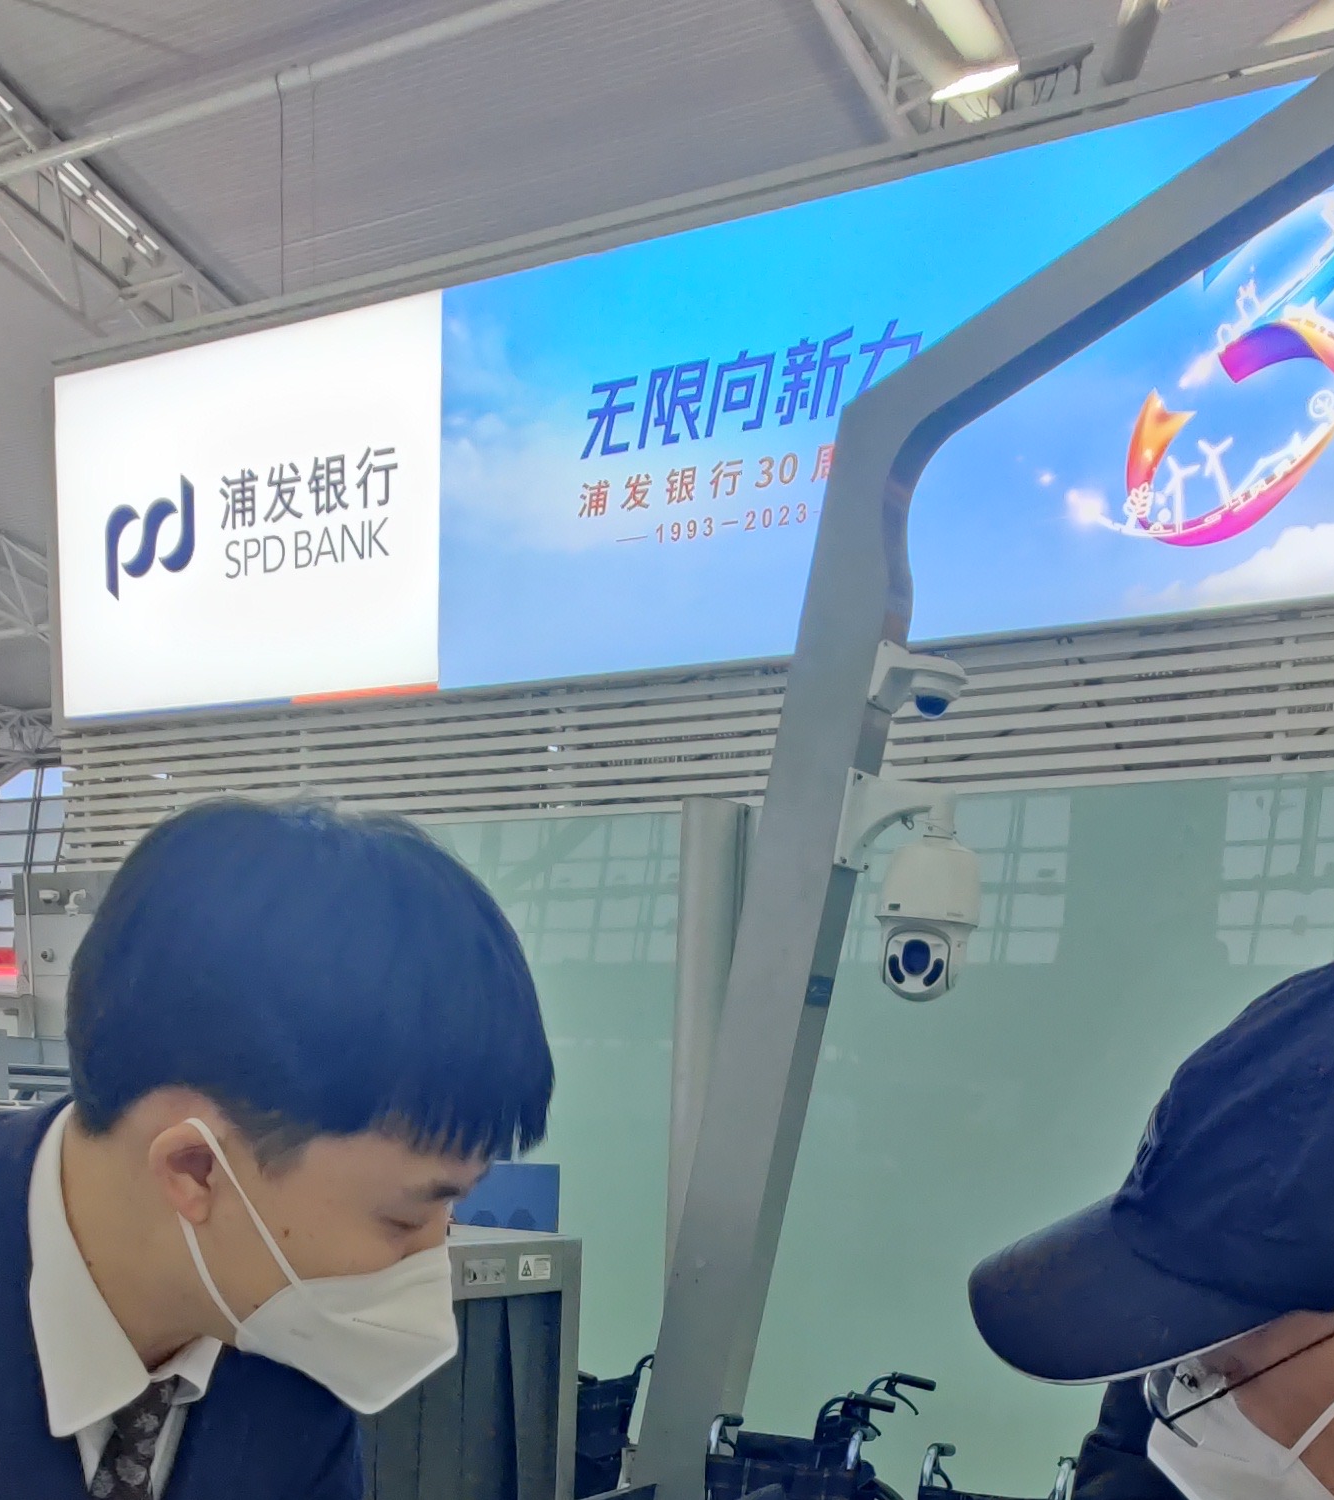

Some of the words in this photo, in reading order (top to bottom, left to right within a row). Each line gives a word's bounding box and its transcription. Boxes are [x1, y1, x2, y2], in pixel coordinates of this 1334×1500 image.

[219, 446, 398, 530] 浦发银行
[225, 535, 286, 579] SPD
[294, 517, 390, 569] BANK
